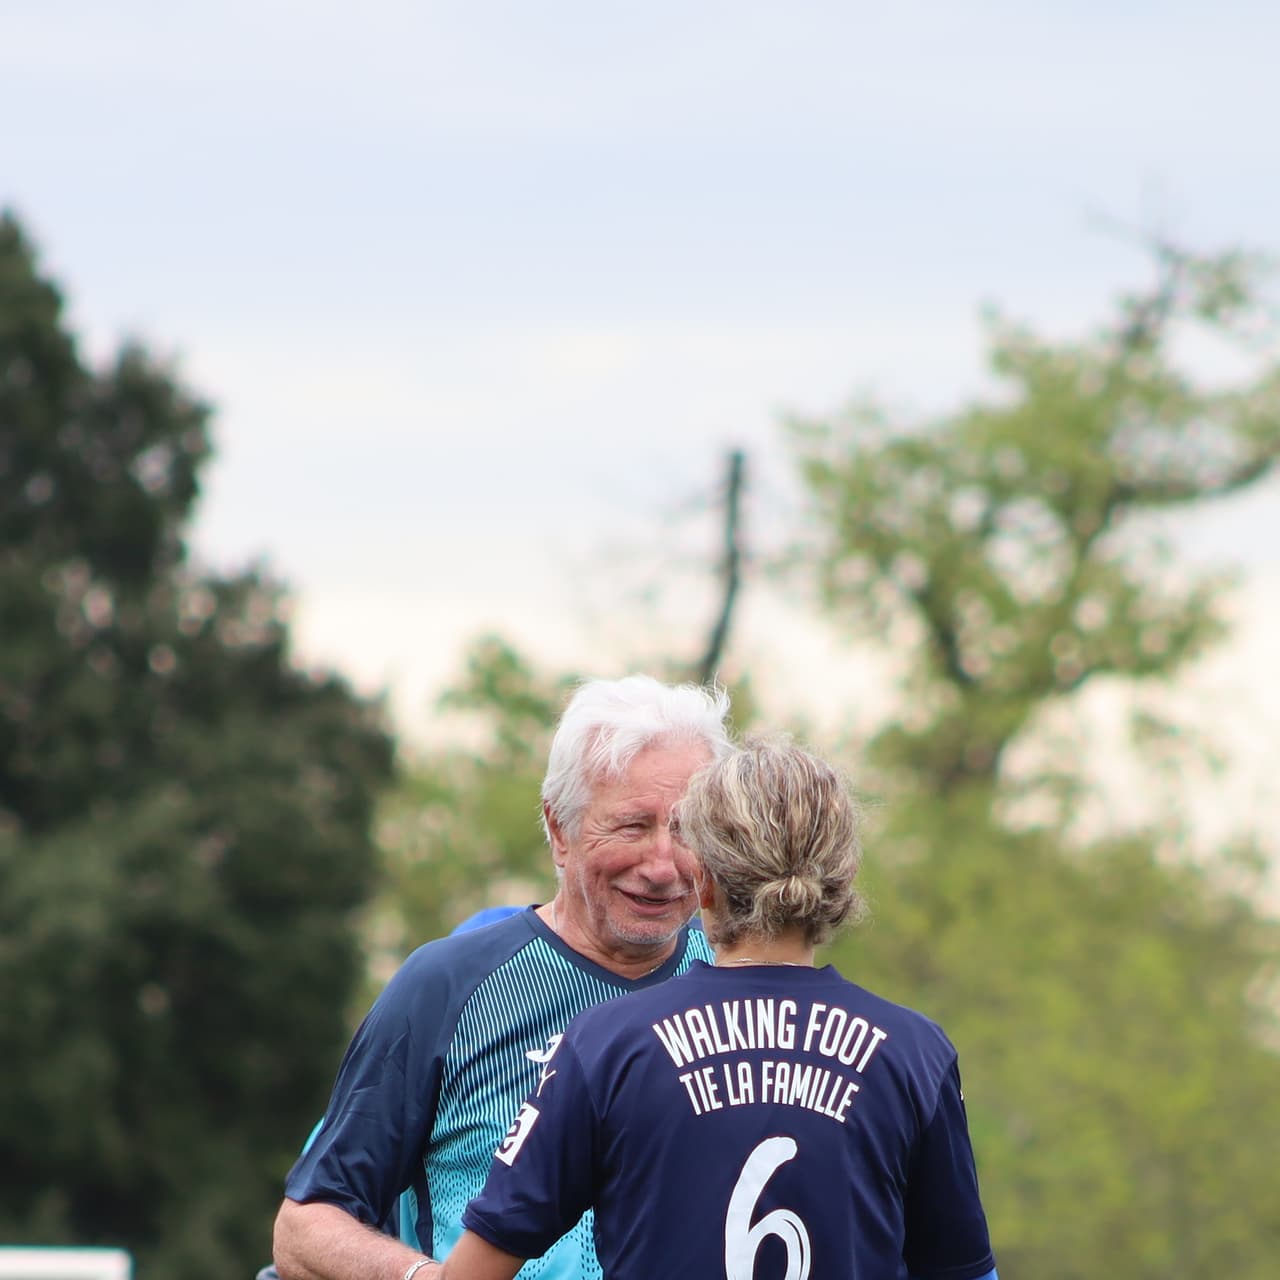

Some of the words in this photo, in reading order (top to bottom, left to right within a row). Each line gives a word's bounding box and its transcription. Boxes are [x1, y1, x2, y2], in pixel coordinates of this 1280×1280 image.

[652, 998, 797, 1068] WALKING
[803, 1003, 887, 1073] FOOT
[679, 1066, 723, 1115] TIE
[724, 1061, 755, 1106] LA
[761, 1061, 860, 1123] FAMILLE
